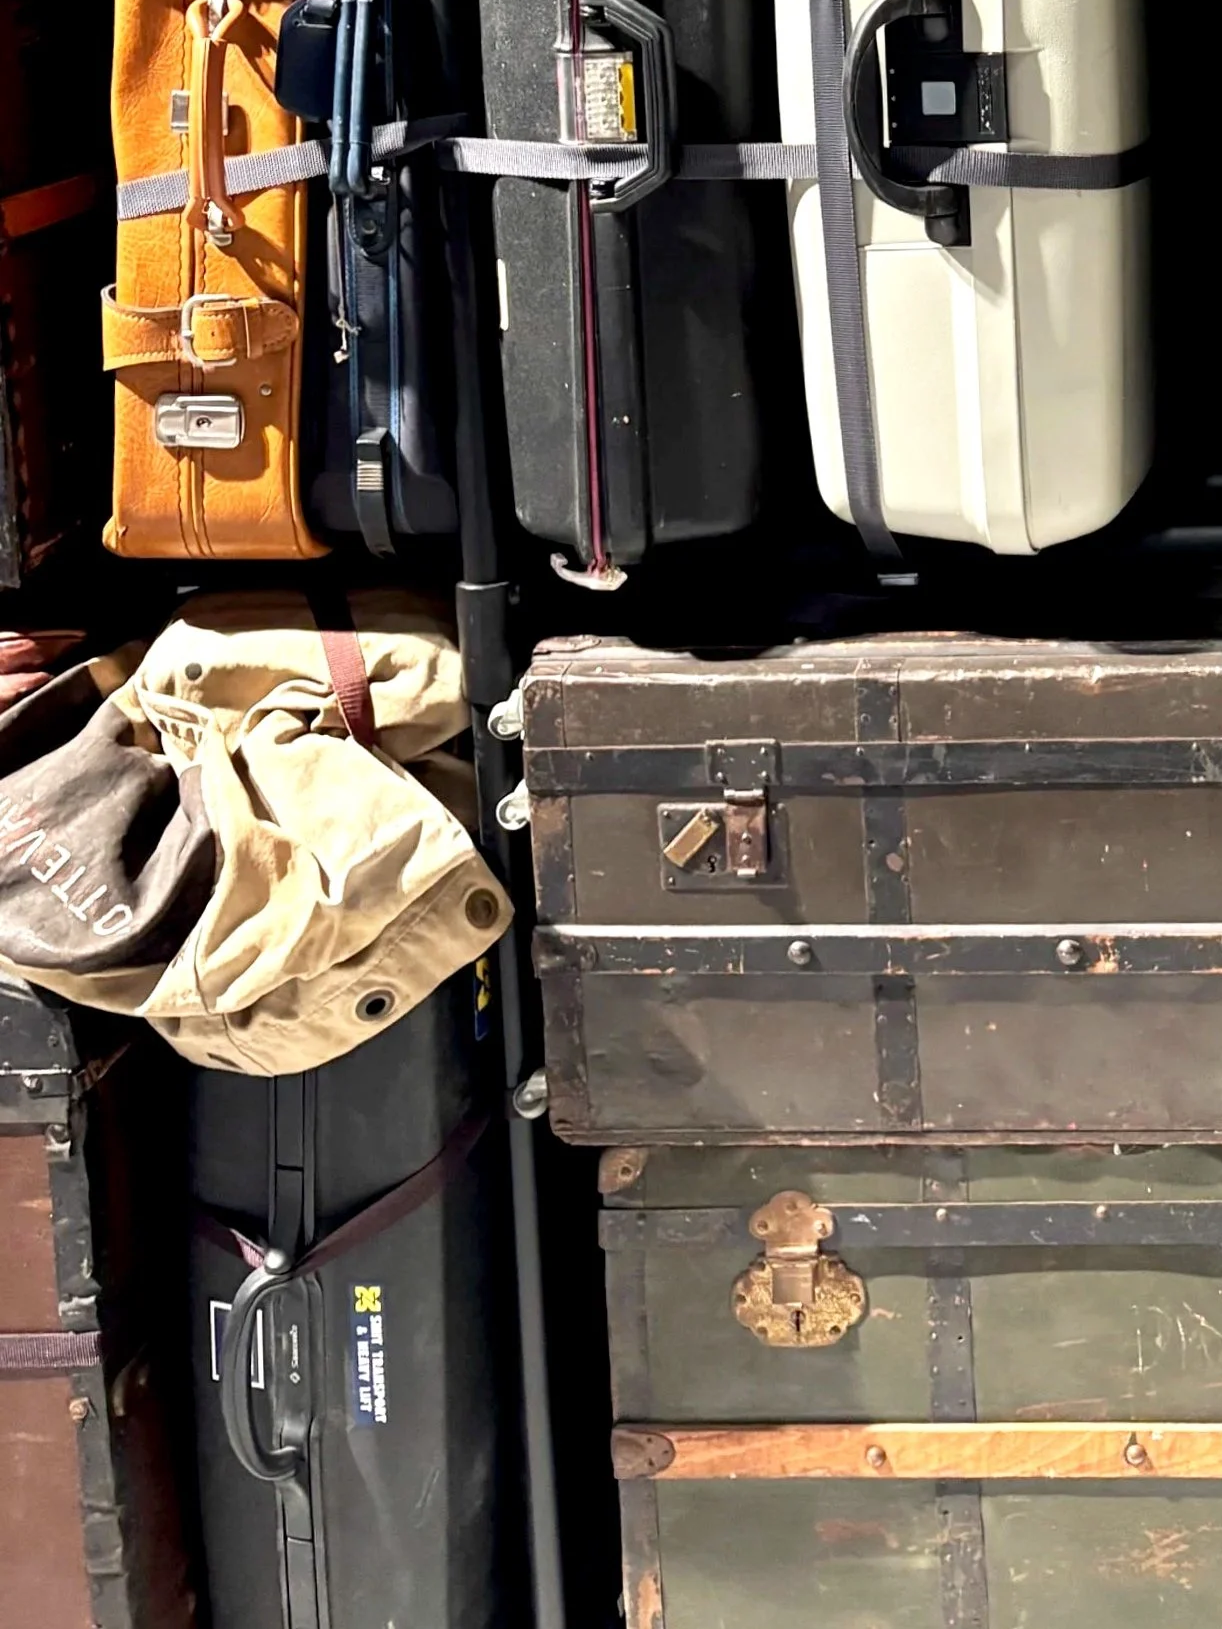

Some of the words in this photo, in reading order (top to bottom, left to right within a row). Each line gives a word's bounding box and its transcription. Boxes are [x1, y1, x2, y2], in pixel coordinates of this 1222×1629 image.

[356, 1325, 368, 1336] &
[359, 1386, 373, 1413] LIFT
[372, 1350, 387, 1424] TRANSPORT
